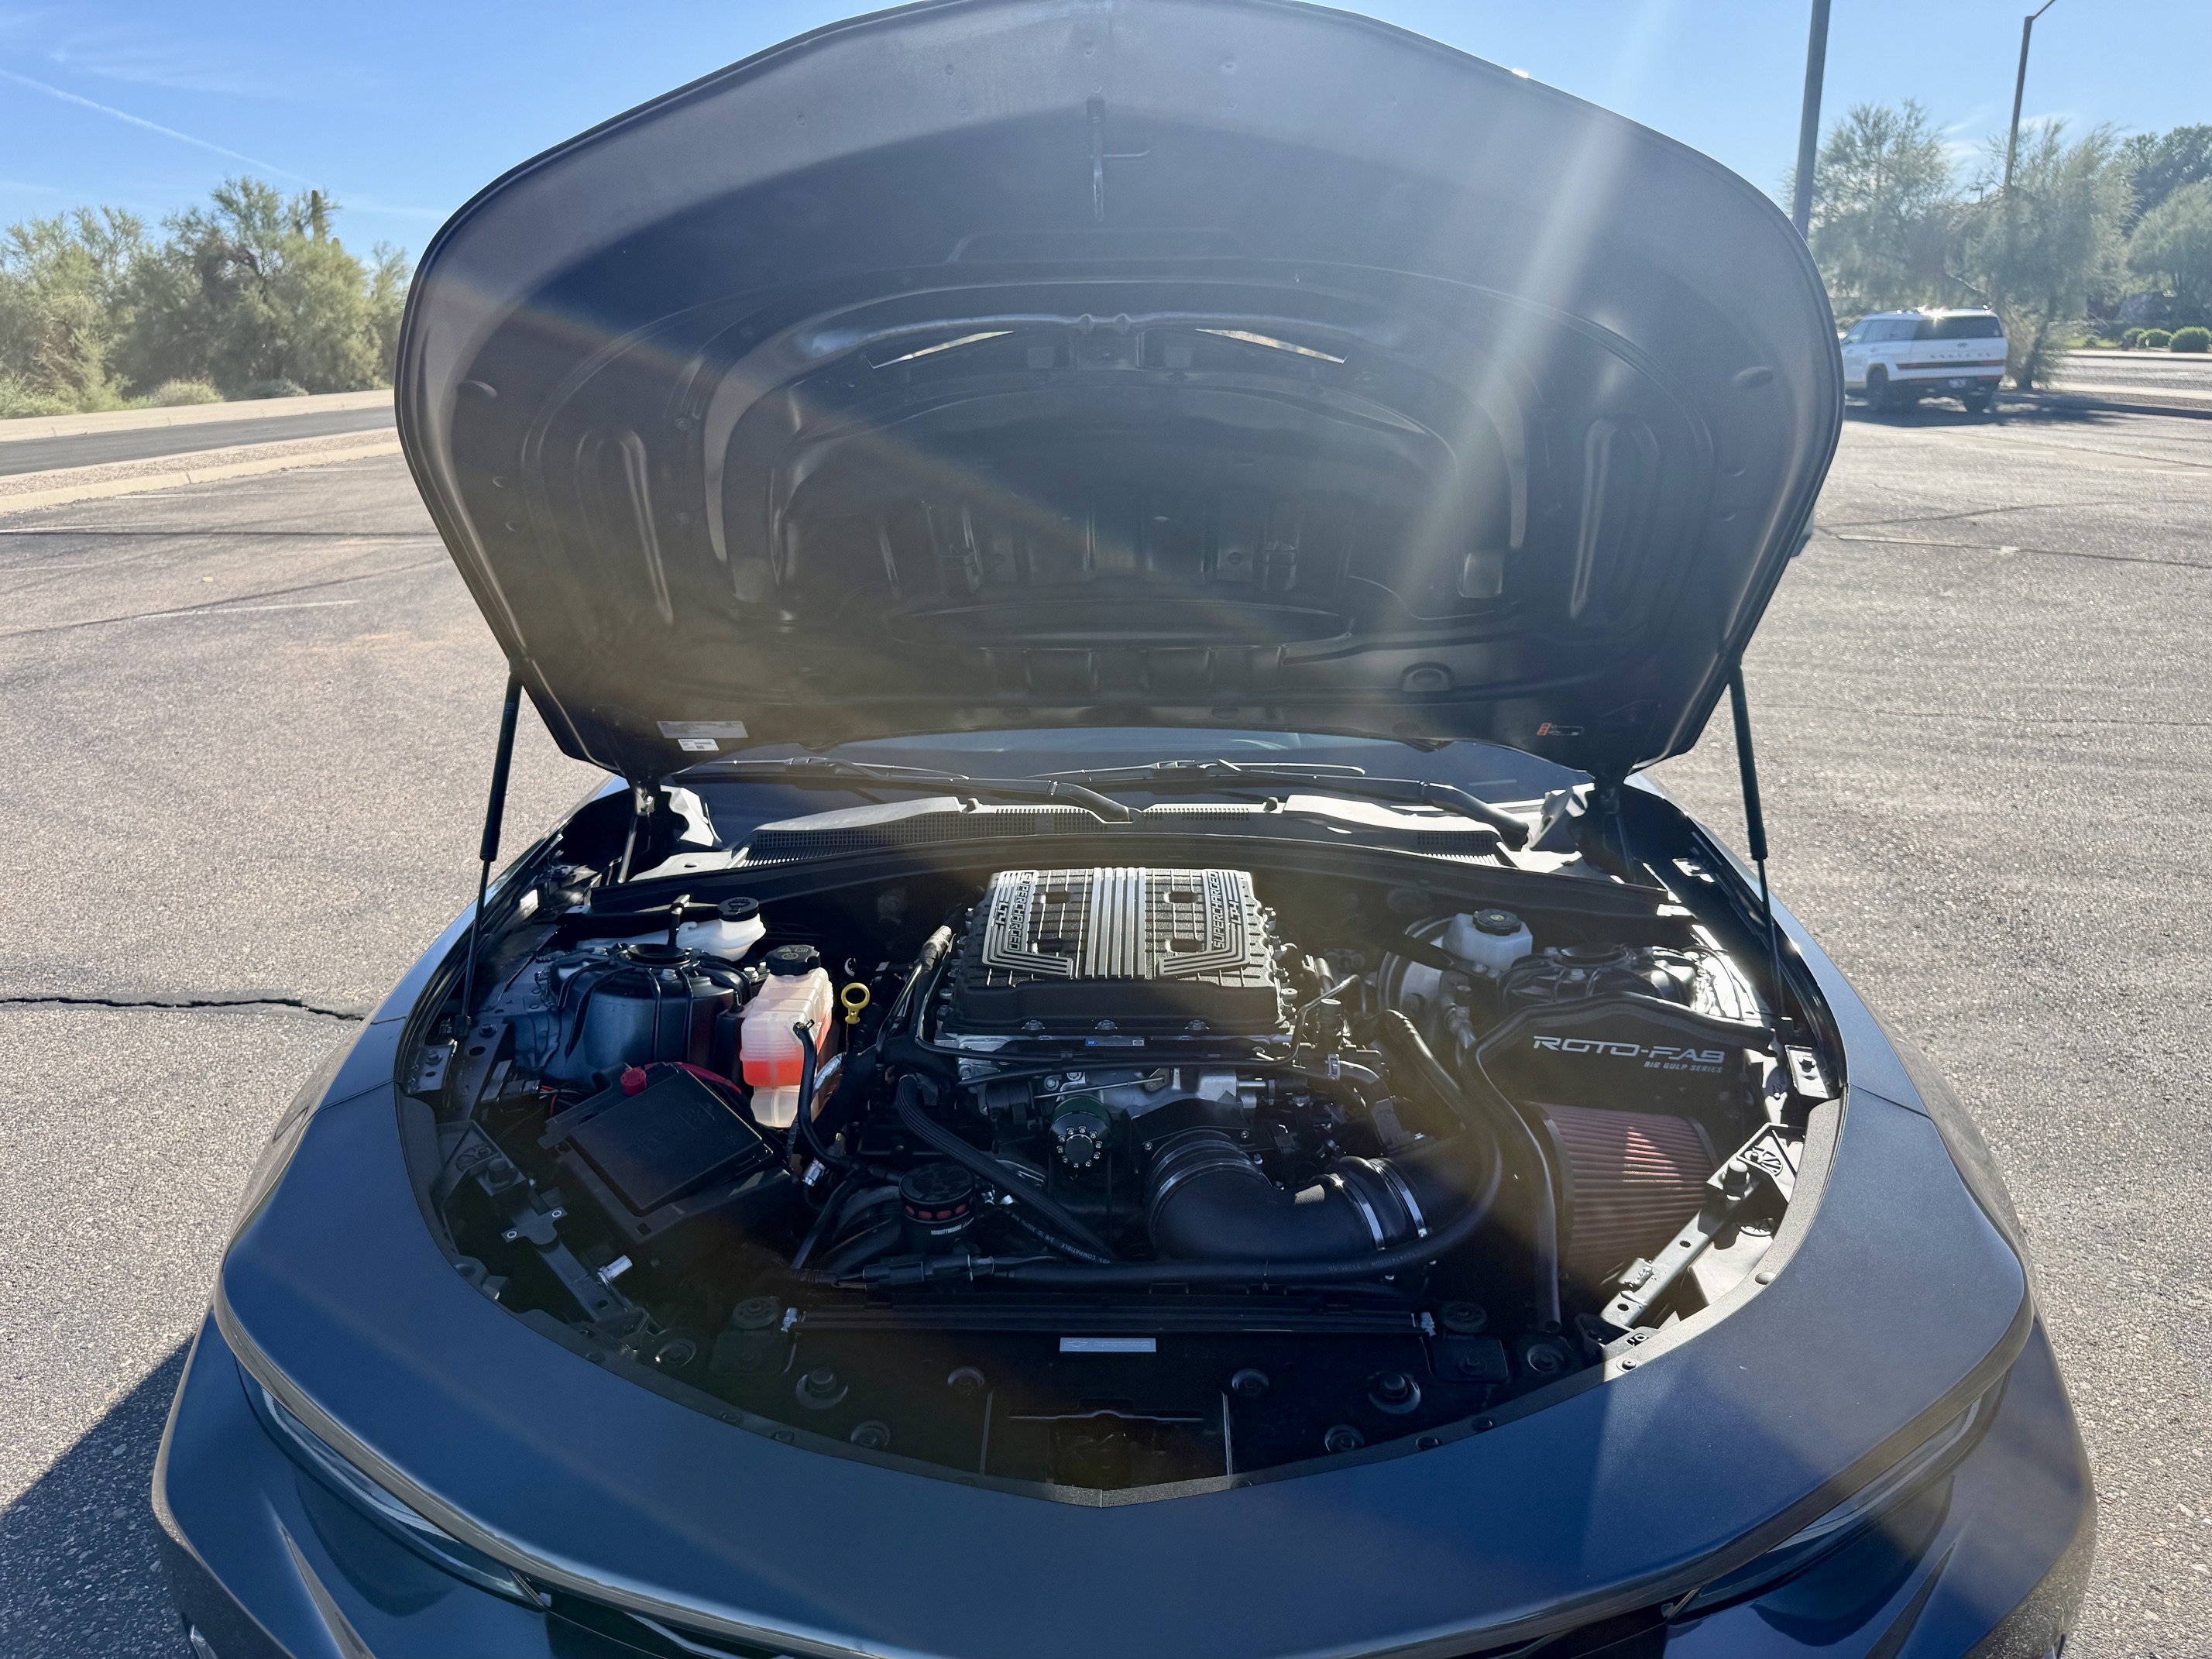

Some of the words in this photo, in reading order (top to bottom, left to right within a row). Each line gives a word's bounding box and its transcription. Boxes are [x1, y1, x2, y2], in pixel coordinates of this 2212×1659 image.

[995, 901, 1008, 925] LT4
[1008, 872, 1033, 951] SUPERCHARGED
[1207, 871, 1225, 949] SUPERCHARGED
[1534, 1036, 1725, 1063] ROTO-FAB
[1644, 1060, 1661, 1069] BIG
[1663, 1062, 1688, 1070] GULP
[1689, 1064, 1724, 1073] SERIES
[1062, 1242, 1096, 1260] COMPATIBLE
